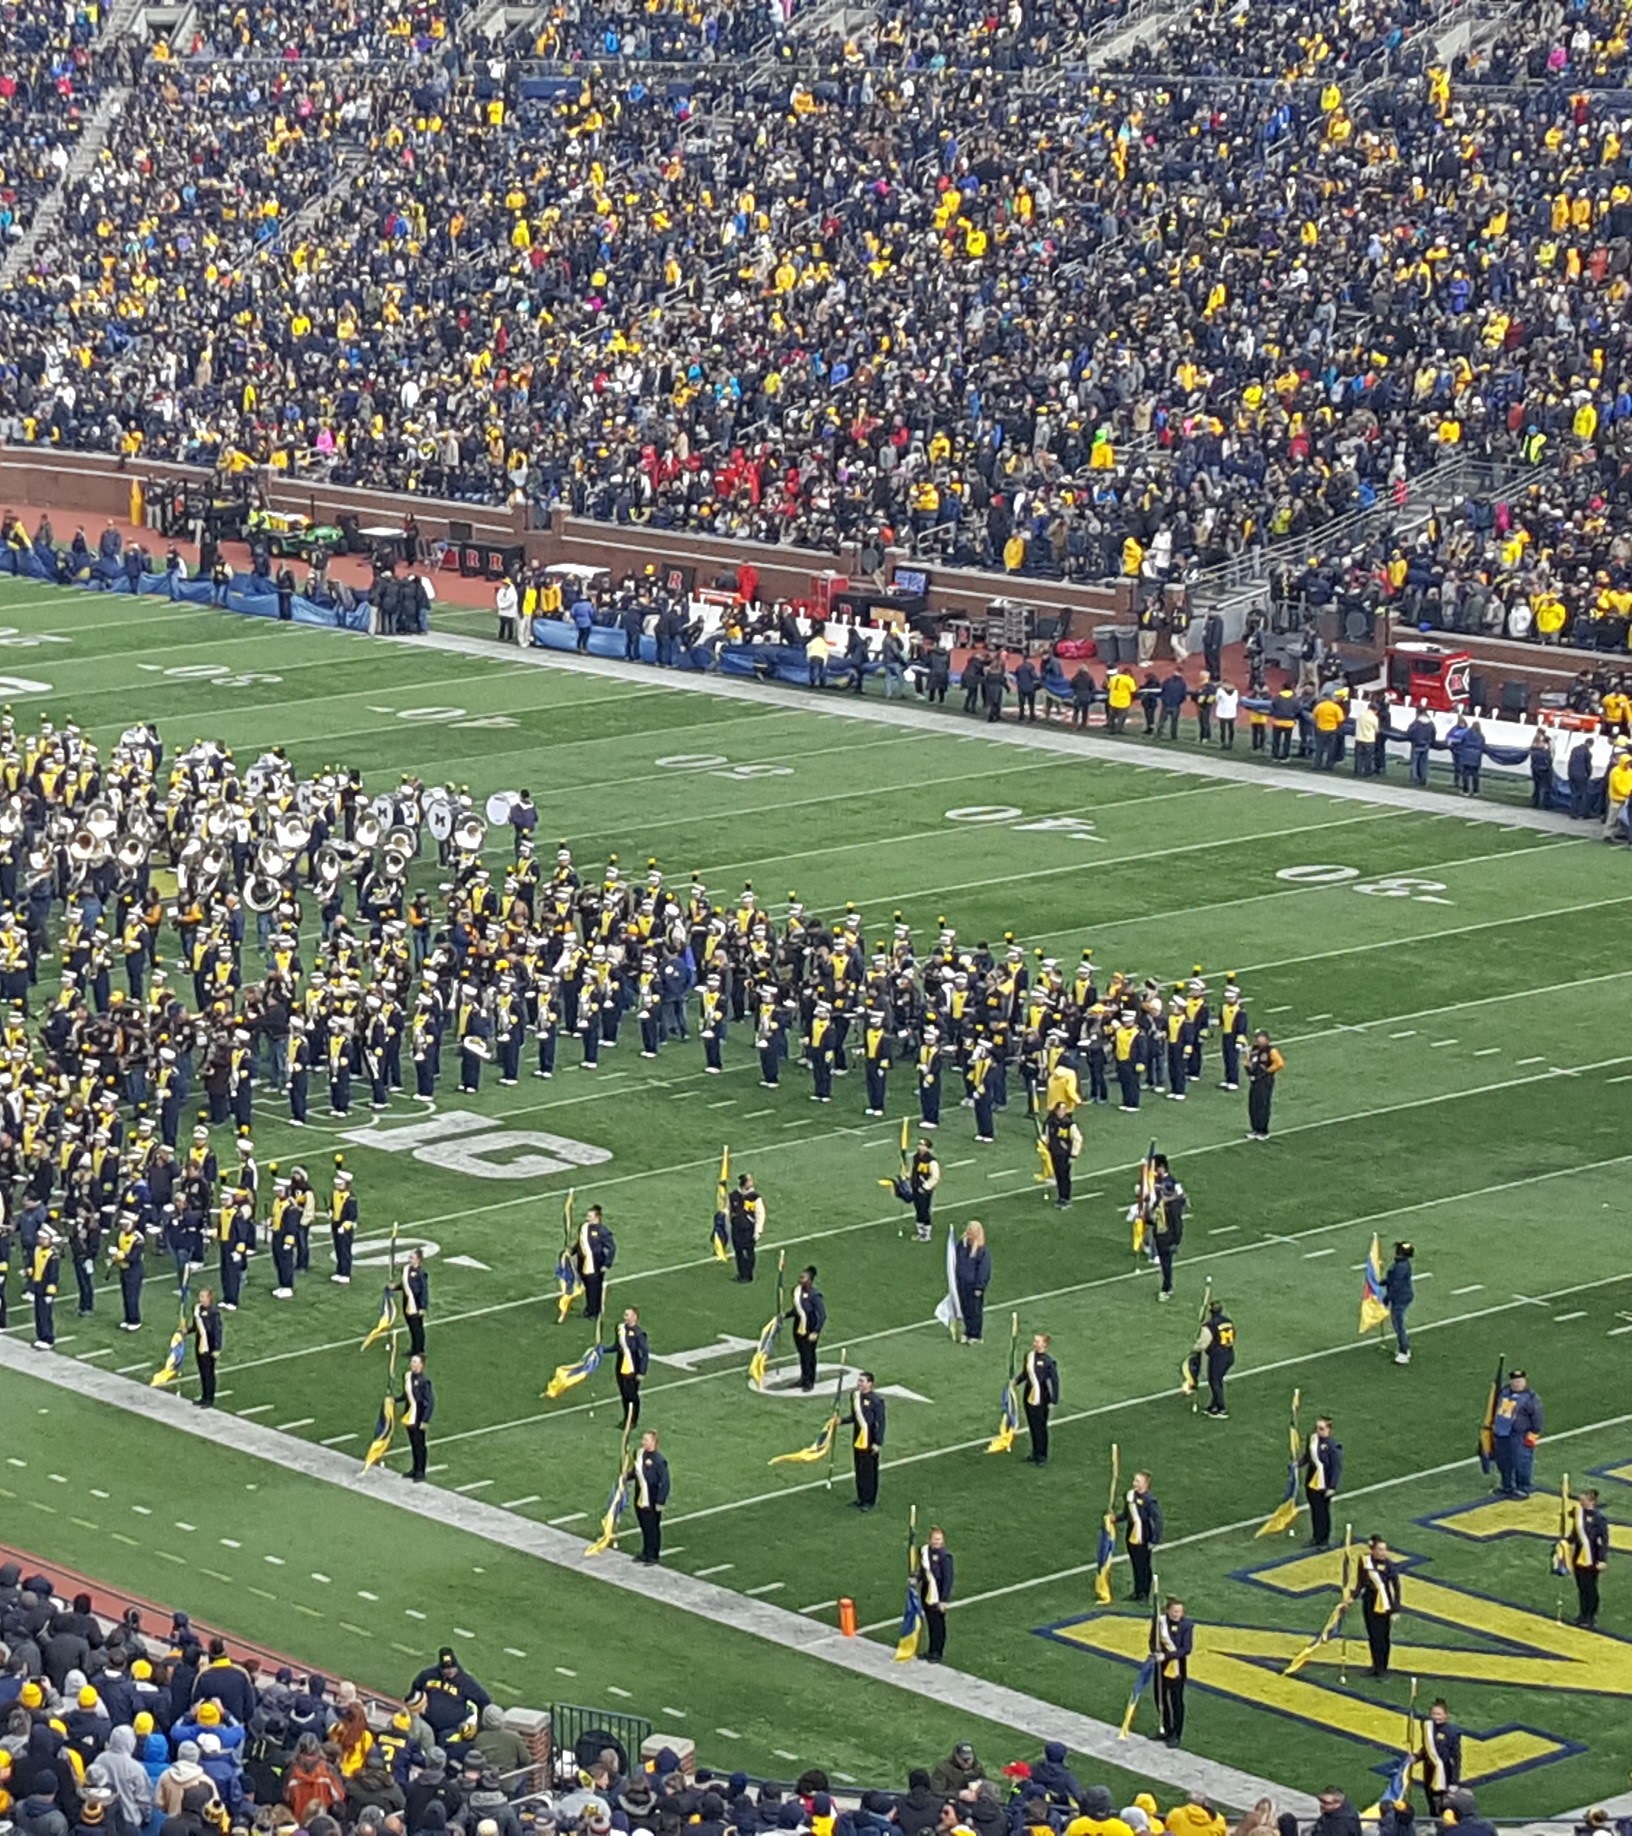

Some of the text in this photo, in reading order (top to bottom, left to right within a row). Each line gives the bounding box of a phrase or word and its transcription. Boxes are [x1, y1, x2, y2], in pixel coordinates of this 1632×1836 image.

[489, 552, 504, 573] R
[667, 571, 683, 591] R
[434, 813, 446, 827] M
